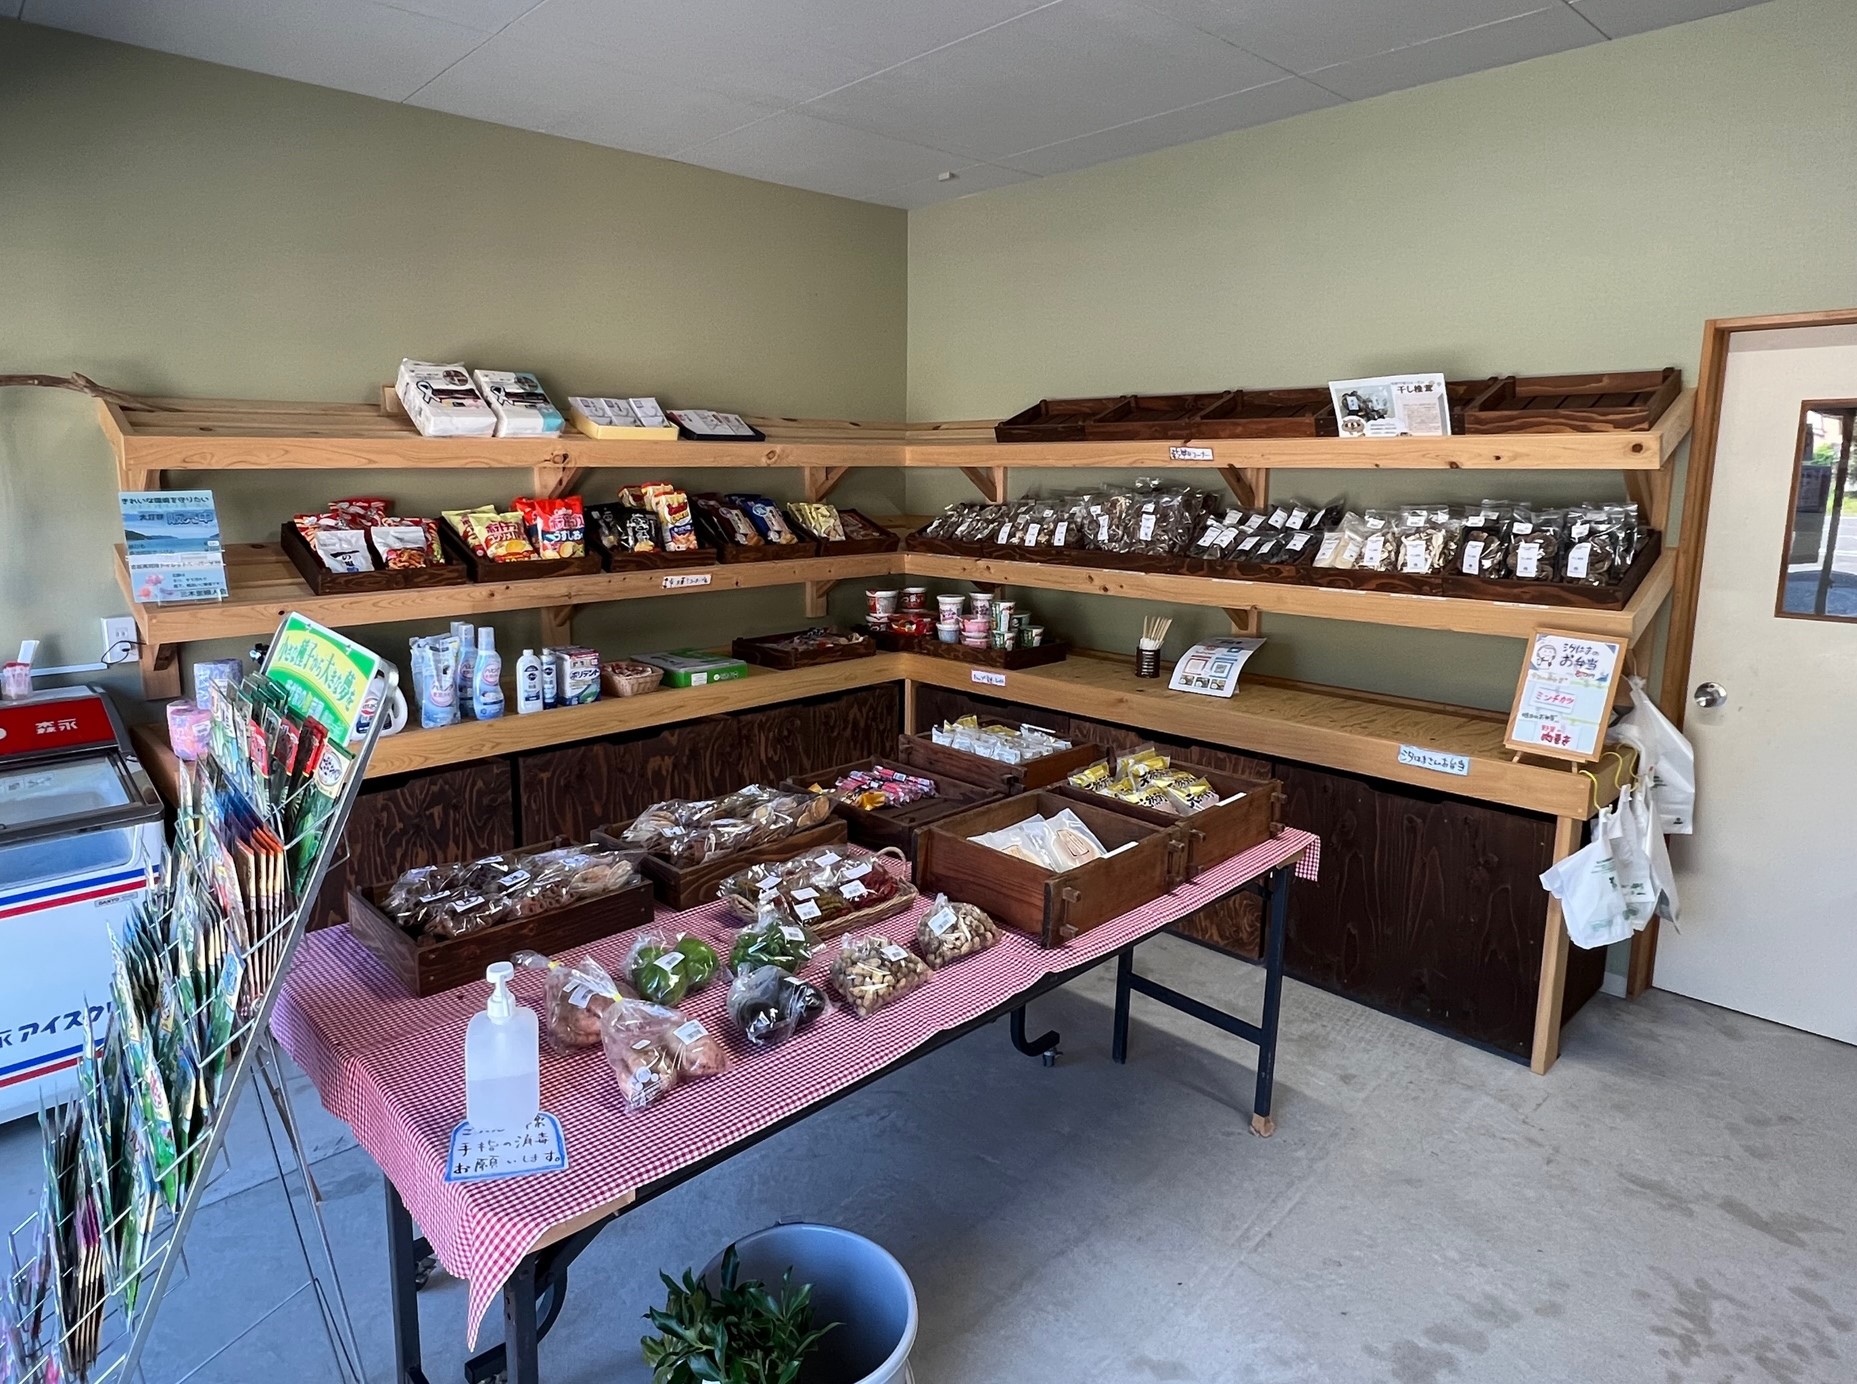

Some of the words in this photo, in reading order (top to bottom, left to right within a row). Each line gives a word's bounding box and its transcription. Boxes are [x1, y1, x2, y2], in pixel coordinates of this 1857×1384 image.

[1535, 690, 1575, 705] ミンチカツ
[0, 1000, 112, 1049] 永アイスク
